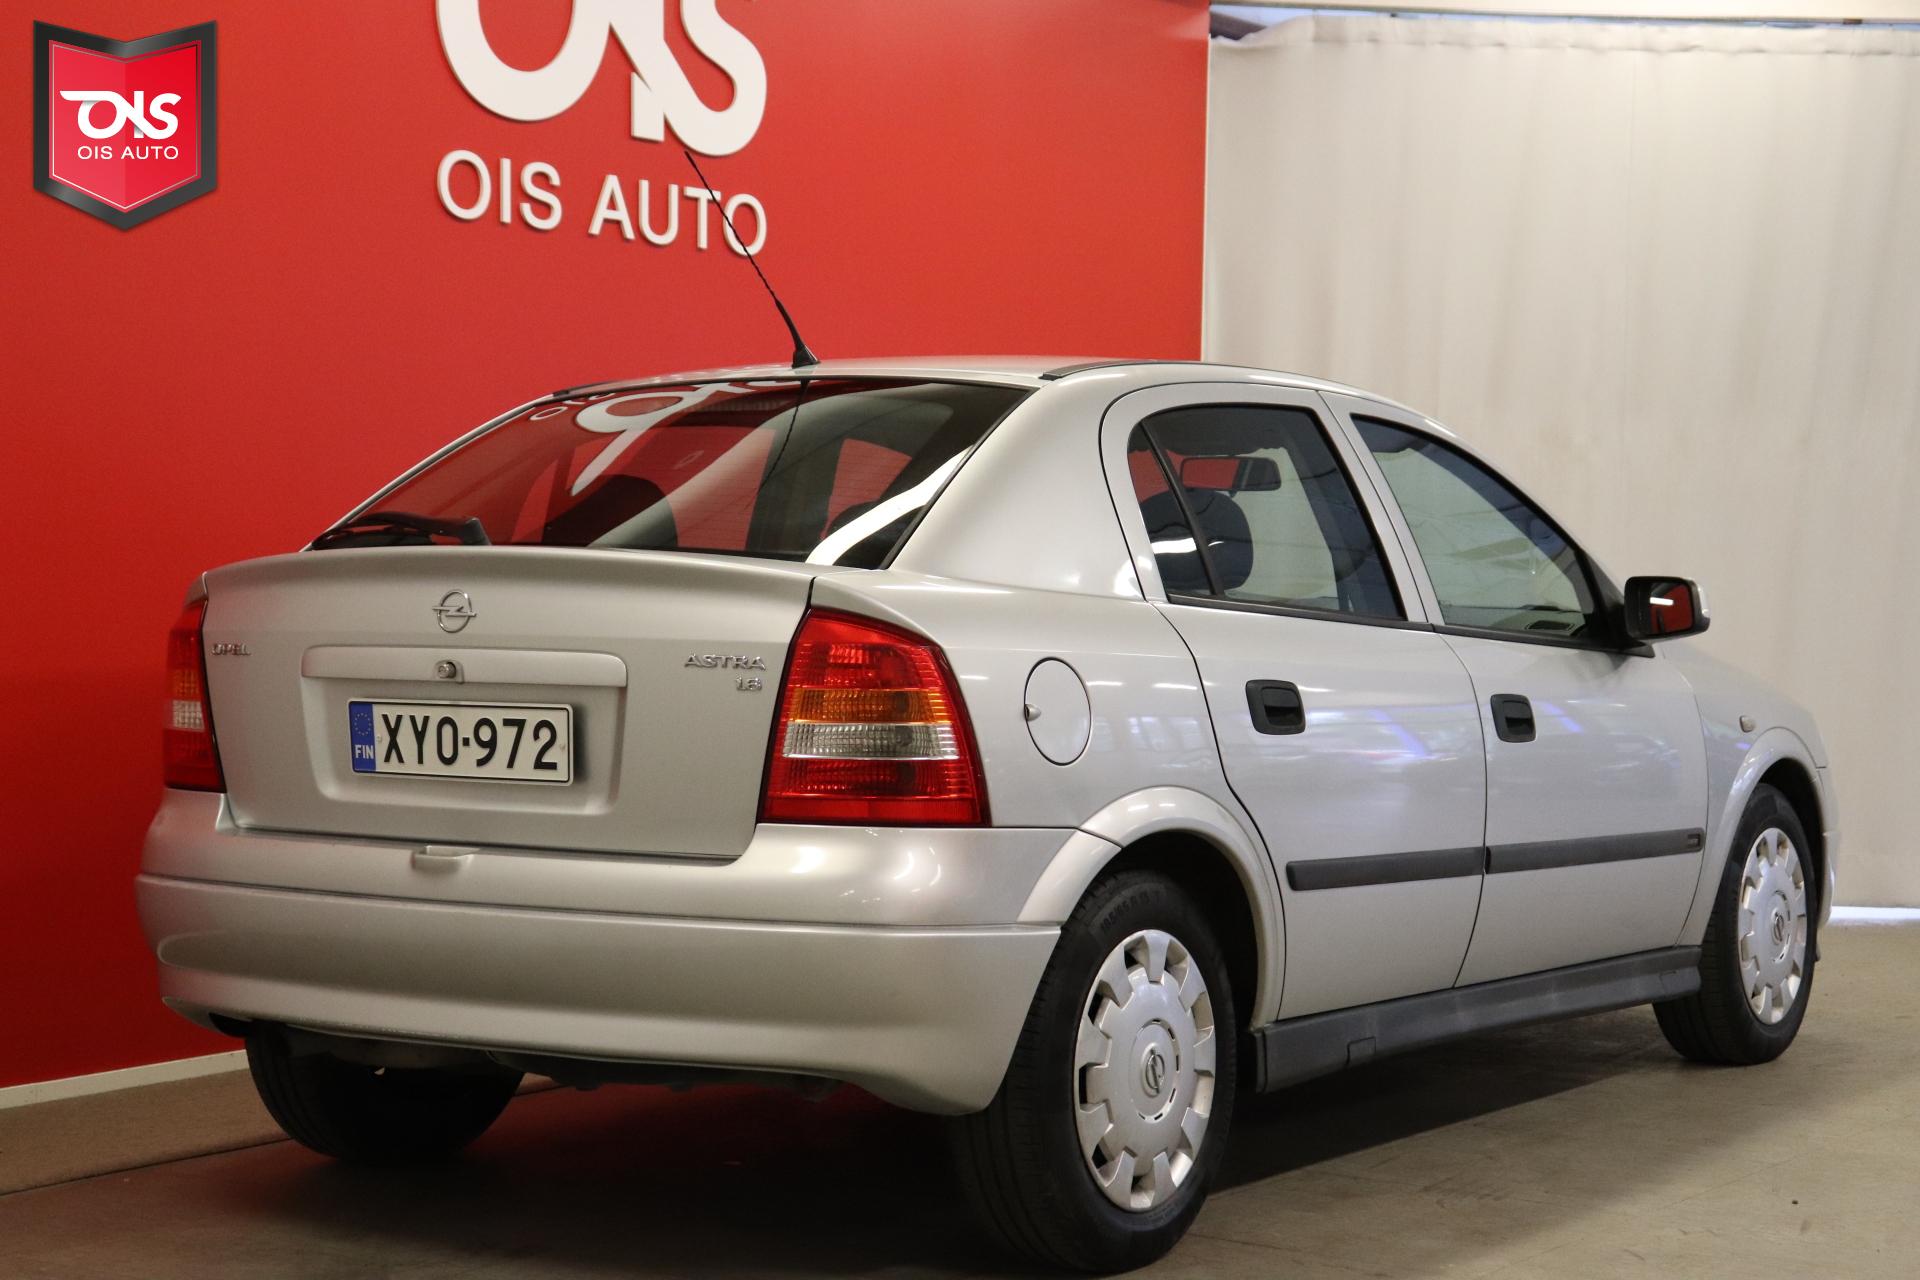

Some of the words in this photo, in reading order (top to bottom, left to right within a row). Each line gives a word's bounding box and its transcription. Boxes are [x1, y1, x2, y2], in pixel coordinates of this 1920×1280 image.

[437, 150, 563, 230] OIS
[588, 174, 767, 256] AUTO
[684, 654, 766, 671] ASTRA
[354, 744, 375, 760] FIN
[381, 713, 558, 771] XYO-972
